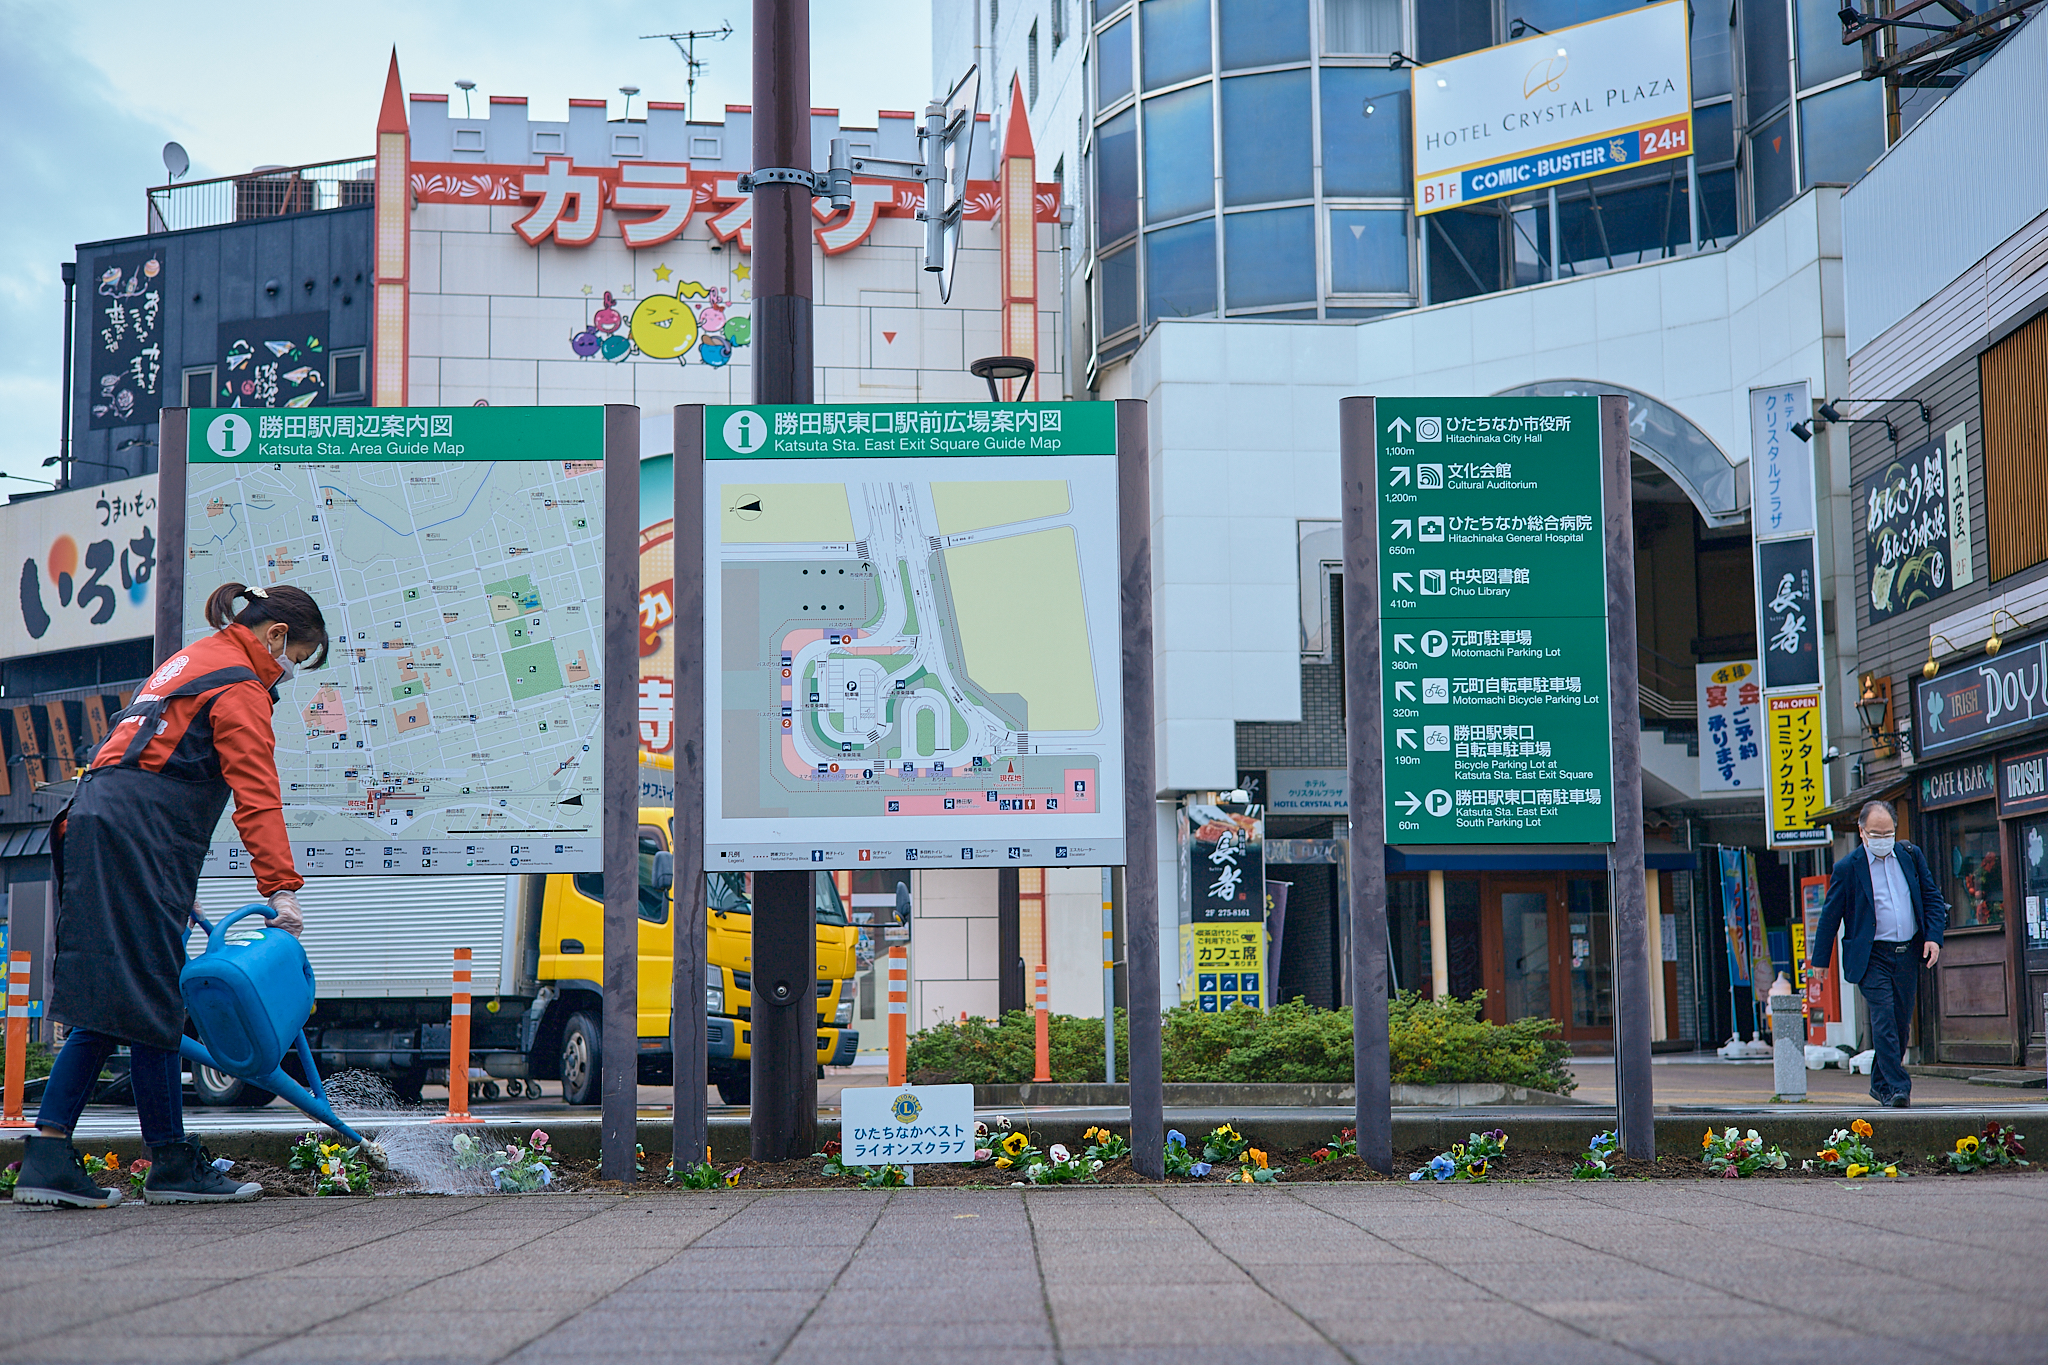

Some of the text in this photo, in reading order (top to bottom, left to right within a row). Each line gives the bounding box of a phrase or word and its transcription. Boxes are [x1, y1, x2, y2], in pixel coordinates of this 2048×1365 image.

[1426, 77, 1676, 151] HOTEL CRYSTAL PLAZA
[1643, 127, 1686, 155] 24H
[1423, 182, 1457, 205] B1F
[1783, 391, 1794, 433] ホテル
[258, 415, 453, 439] 勝田駅周辺案内図
[774, 409, 1062, 435] 勝田駅東口駅前広場案内図
[1446, 415, 1572, 432] ひたちなか市役所
[774, 436, 1062, 452] Katsuta Sta. East Exit Square Guide Map
[1446, 433, 1543, 445] Hitachinaka City Hall
[258, 441, 465, 457] Katsuta Sta. Area Guide Map
[1385, 446, 1415, 457] 1,100m
[1765, 395, 1783, 530] クリスタルプラザ
[1447, 463, 1512, 479] 文化会館
[1447, 480, 1538, 490] Cultural Auditorium
[1867, 447, 1945, 533] あんこう鍋
[1385, 493, 1418, 503] 1,200m
[96, 489, 156, 527] うまいもの
[1448, 515, 1593, 532] ひたちなか総合病院
[1448, 533, 1584, 544] Hitachinaka General Hospital
[1388, 545, 1415, 555] 650m
[1955, 558, 1967, 577] 2F
[20, 525, 157, 640] いろは
[1449, 568, 1530, 585] 中央図書館
[1449, 586, 1511, 598] Chuo Library
[1390, 599, 1417, 609] 410m
[1768, 572, 1807, 654] 長者
[1451, 629, 1533, 647] 元町駐車場
[1451, 647, 1561, 659] Motomachi Parking Lot
[1391, 660, 1418, 670] 360m
[1452, 677, 1582, 694] 元町自転車駐車場
[1452, 694, 1600, 706] Motomachi Bicycle Parking Lot
[1772, 698, 1816, 710] 24H OPEN
[1951, 689, 1979, 718] IRISH
[1392, 708, 1420, 718] 320m
[1453, 725, 1534, 741] 勝田駅東口
[1732, 706, 1759, 760] ご予約
[1455, 741, 1552, 758] 自転車駐車場
[1394, 755, 1421, 765] 190m
[1454, 760, 1558, 772] Bicycle Parking Lot at
[1796, 710, 1817, 825] インターネット
[1454, 769, 1594, 781] Katsuta Sta. East Exit Square
[1777, 714, 1797, 827] コミックカフェ
[2006, 757, 2045, 799] IRISH
[1304, 780, 1327, 788] ホテル
[1930, 771, 1955, 800] CAFE
[1964, 764, 1987, 792] BAR
[1288, 789, 1343, 797] クリスタルプラザ
[1455, 789, 1602, 806] 勝田駅東口南駐車場
[1455, 806, 1559, 817] Katsuta Sta. East Exit
[1398, 821, 1420, 830] 60m
[1456, 817, 1542, 829] South Parking Lot
[1205, 909, 1216, 917] 2F
[1199, 946, 1257, 960] カフェ席
[854, 1124, 965, 1141] ひたちなかベスト
[854, 1140, 966, 1158] ライオンズクラブ
